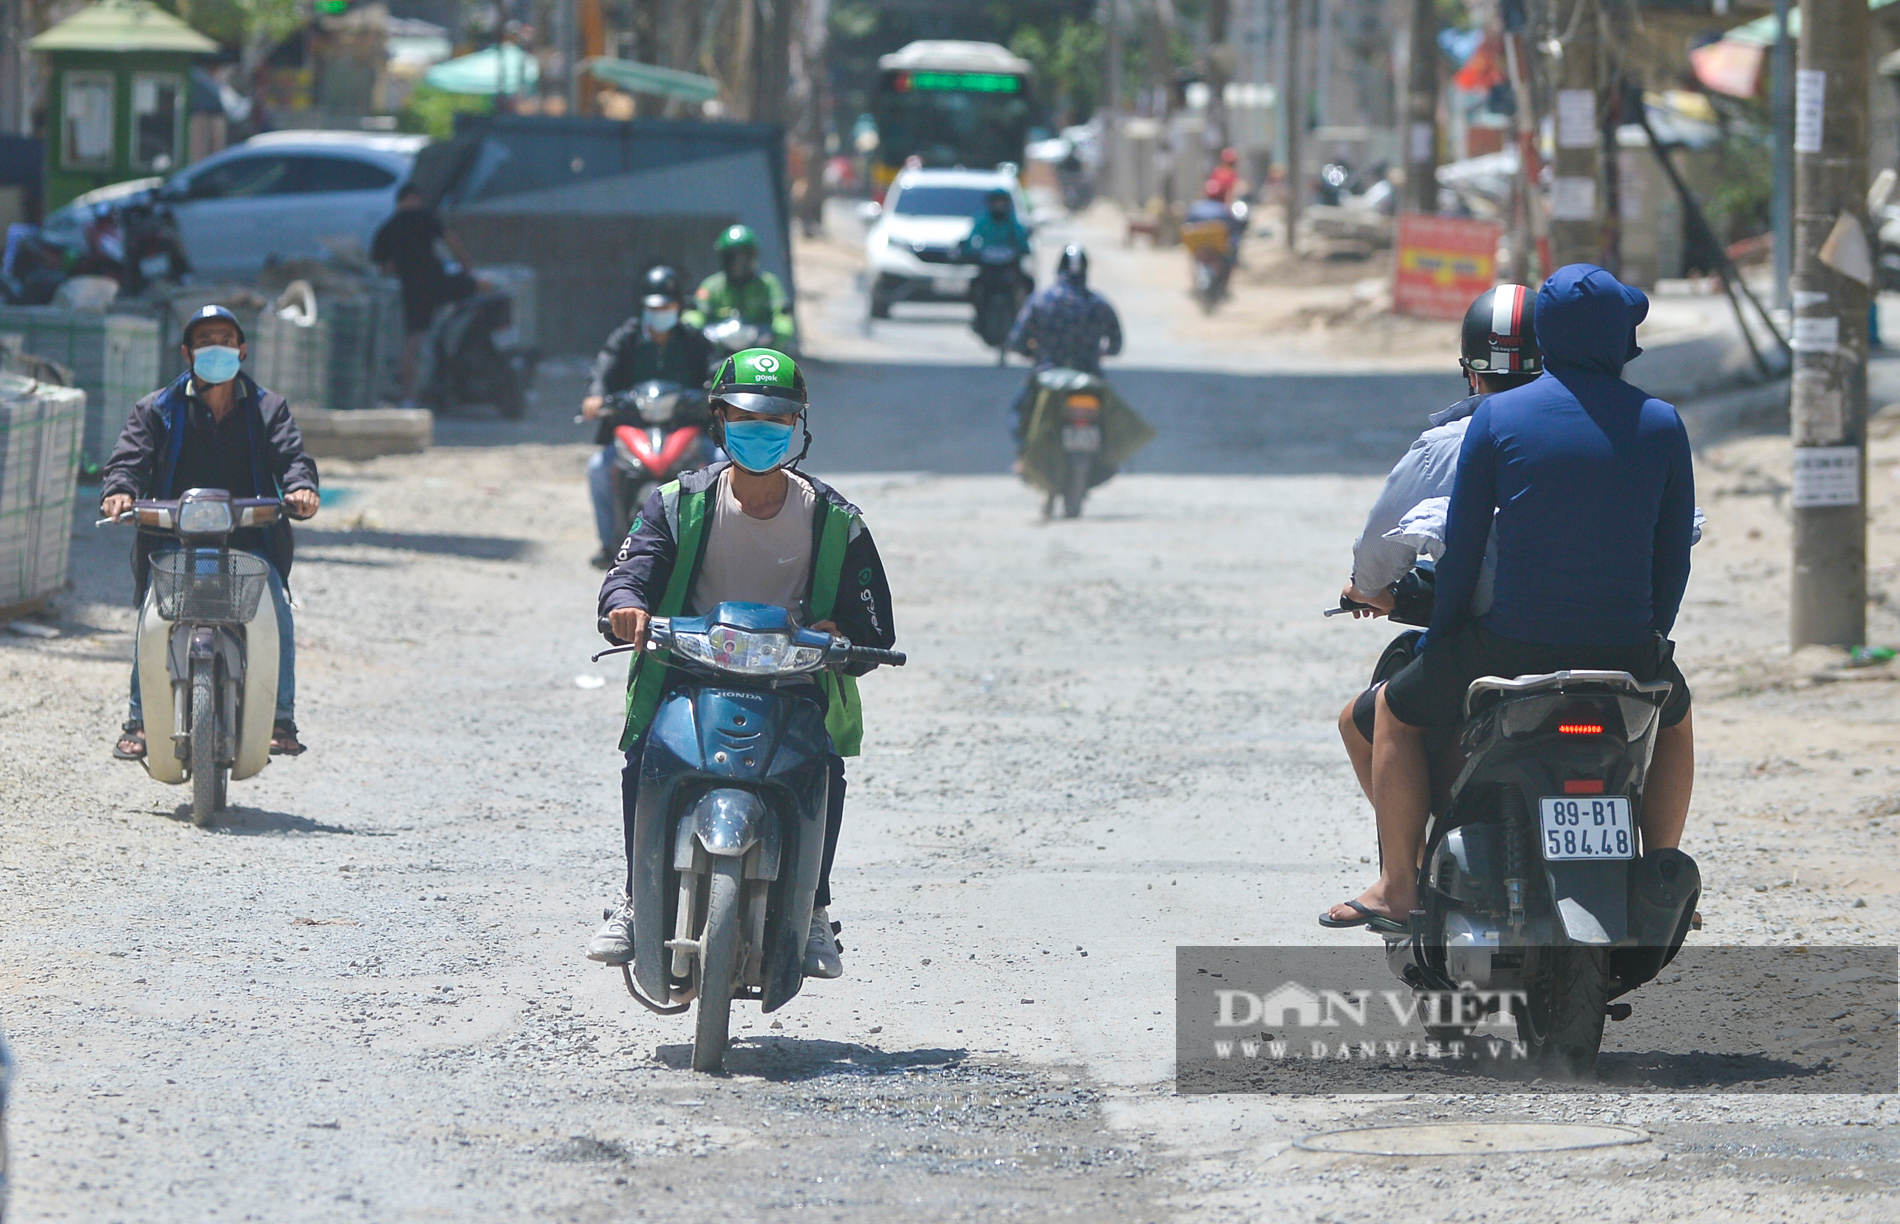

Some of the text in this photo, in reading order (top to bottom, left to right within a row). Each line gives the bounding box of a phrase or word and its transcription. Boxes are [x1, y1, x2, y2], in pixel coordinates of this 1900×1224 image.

[755, 374, 778, 382] gojek
[717, 691, 763, 701] HONDA
[1553, 801, 1616, 826] 89-B1
[1548, 829, 1628, 855] 584.48
